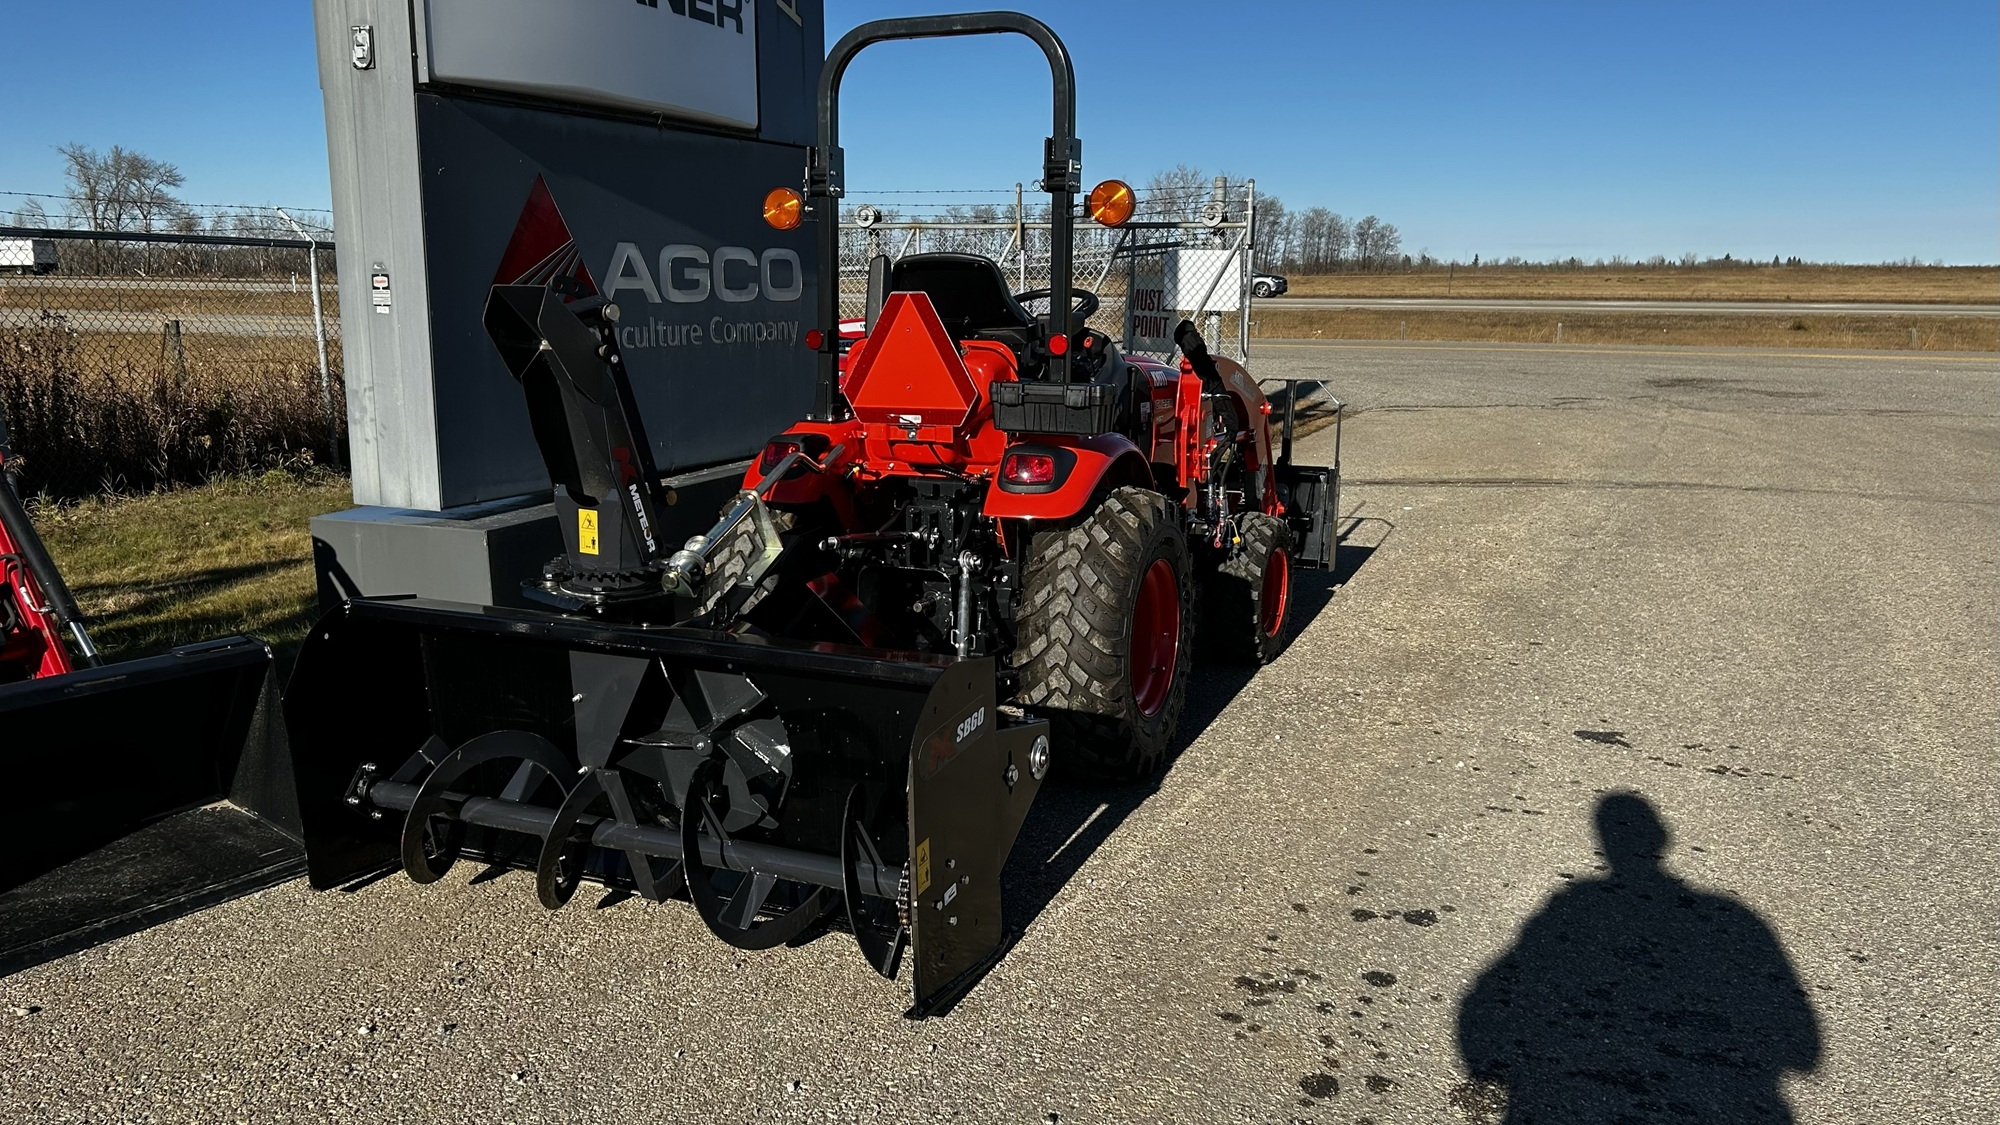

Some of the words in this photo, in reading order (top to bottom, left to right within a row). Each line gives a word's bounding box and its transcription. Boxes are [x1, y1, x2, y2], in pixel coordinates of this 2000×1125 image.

[602, 242, 803, 304] AGCO
[709, 315, 800, 350] Company
[1133, 315, 1170, 339] POINT
[628, 483, 656, 554] METEOR
[956, 706, 985, 743] SB60
